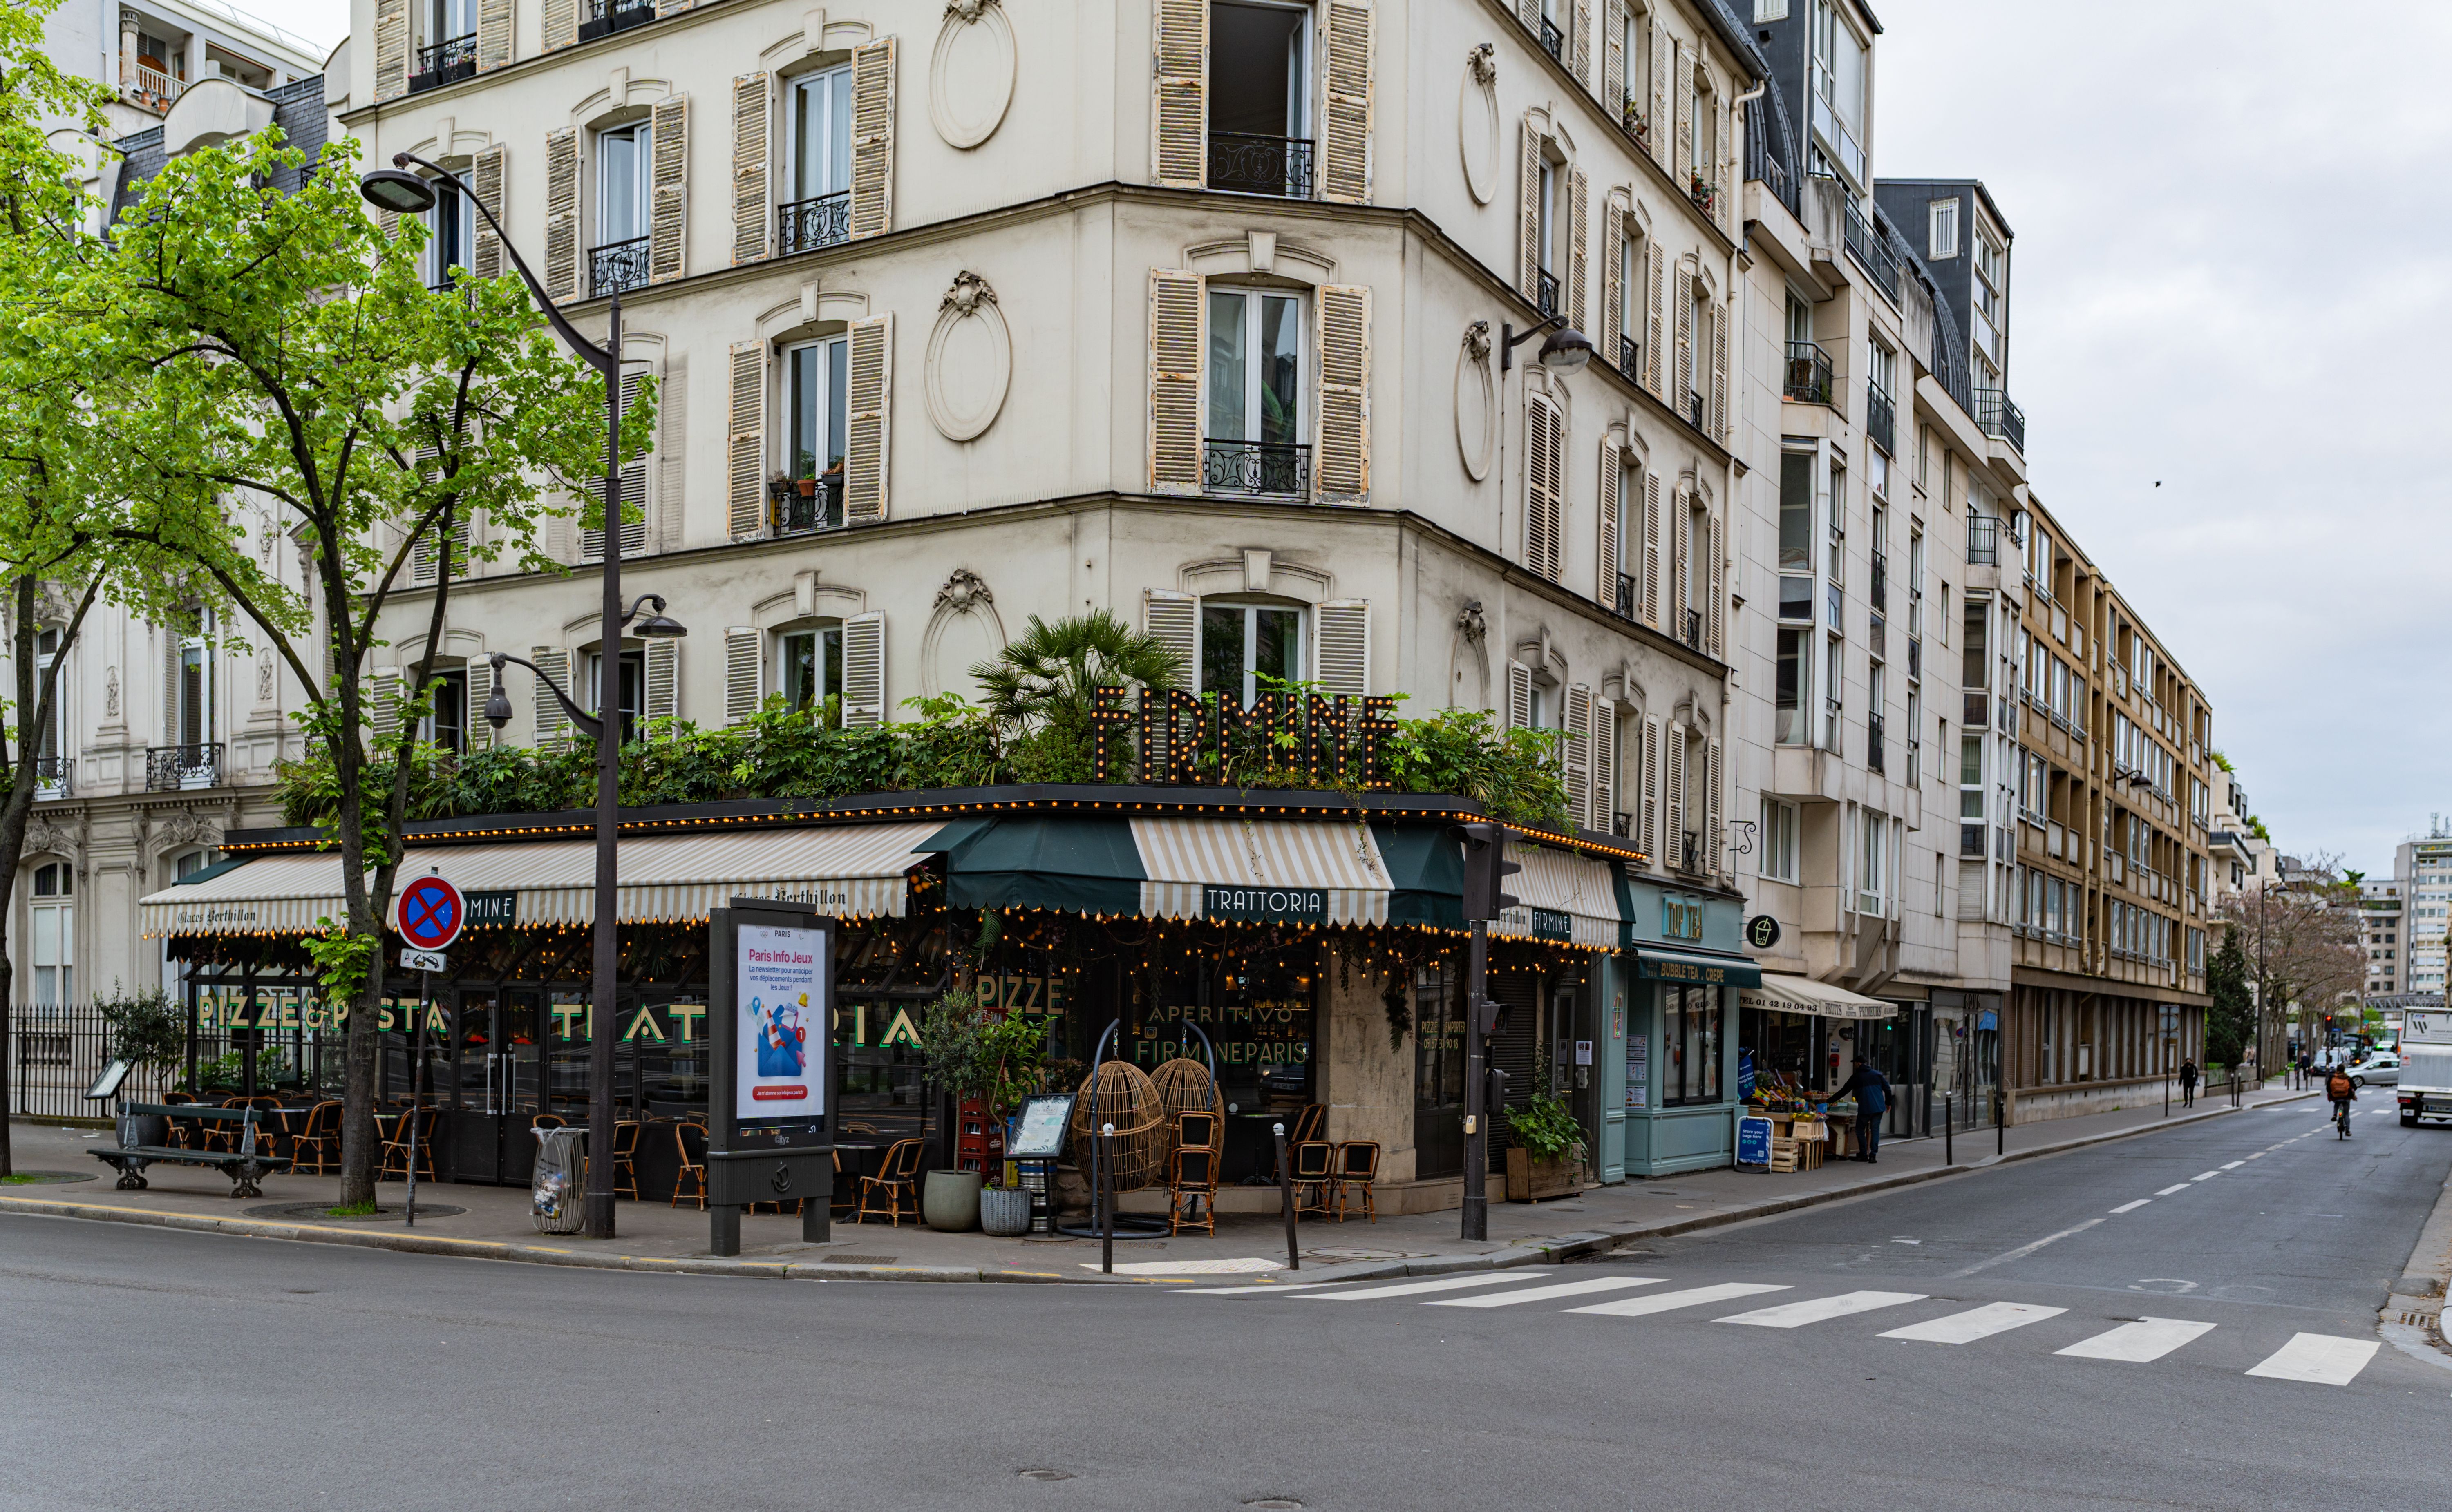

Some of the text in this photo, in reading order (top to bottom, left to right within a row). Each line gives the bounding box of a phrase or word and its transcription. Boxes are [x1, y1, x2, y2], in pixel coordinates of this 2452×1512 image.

[1089, 686, 1398, 788] FIRMINE
[465, 898, 512, 918] MINE
[1208, 889, 1320, 913] TRATTORIA
[178, 907, 256, 925] Glaces Berthillon
[1496, 909, 1526, 927] erthillon
[1534, 911, 1571, 934] FIRMINE
[1668, 901, 1703, 939] TOP TEA
[749, 949, 813, 964] Paris Info Jeux
[759, 975, 792, 983] déplacements
[793, 967, 813, 976] anticiper
[1660, 962, 1686, 978] BUBBLE
[1687, 965, 1699, 980] TEA
[1705, 967, 1724, 983] CREPE
[977, 975, 1065, 1017] PIZZE
[1146, 1006, 1293, 1024] APERITIVO
[1825, 1003, 1842, 1016] FRUITS
[1859, 1006, 1882, 1017] PRIMEURS
[799, 1030, 803, 1039] 1
[1421, 1021, 1465, 1034] PIZZE EMPORTER
[1424, 1038, 1458, 1050] 09 87 33 90 18
